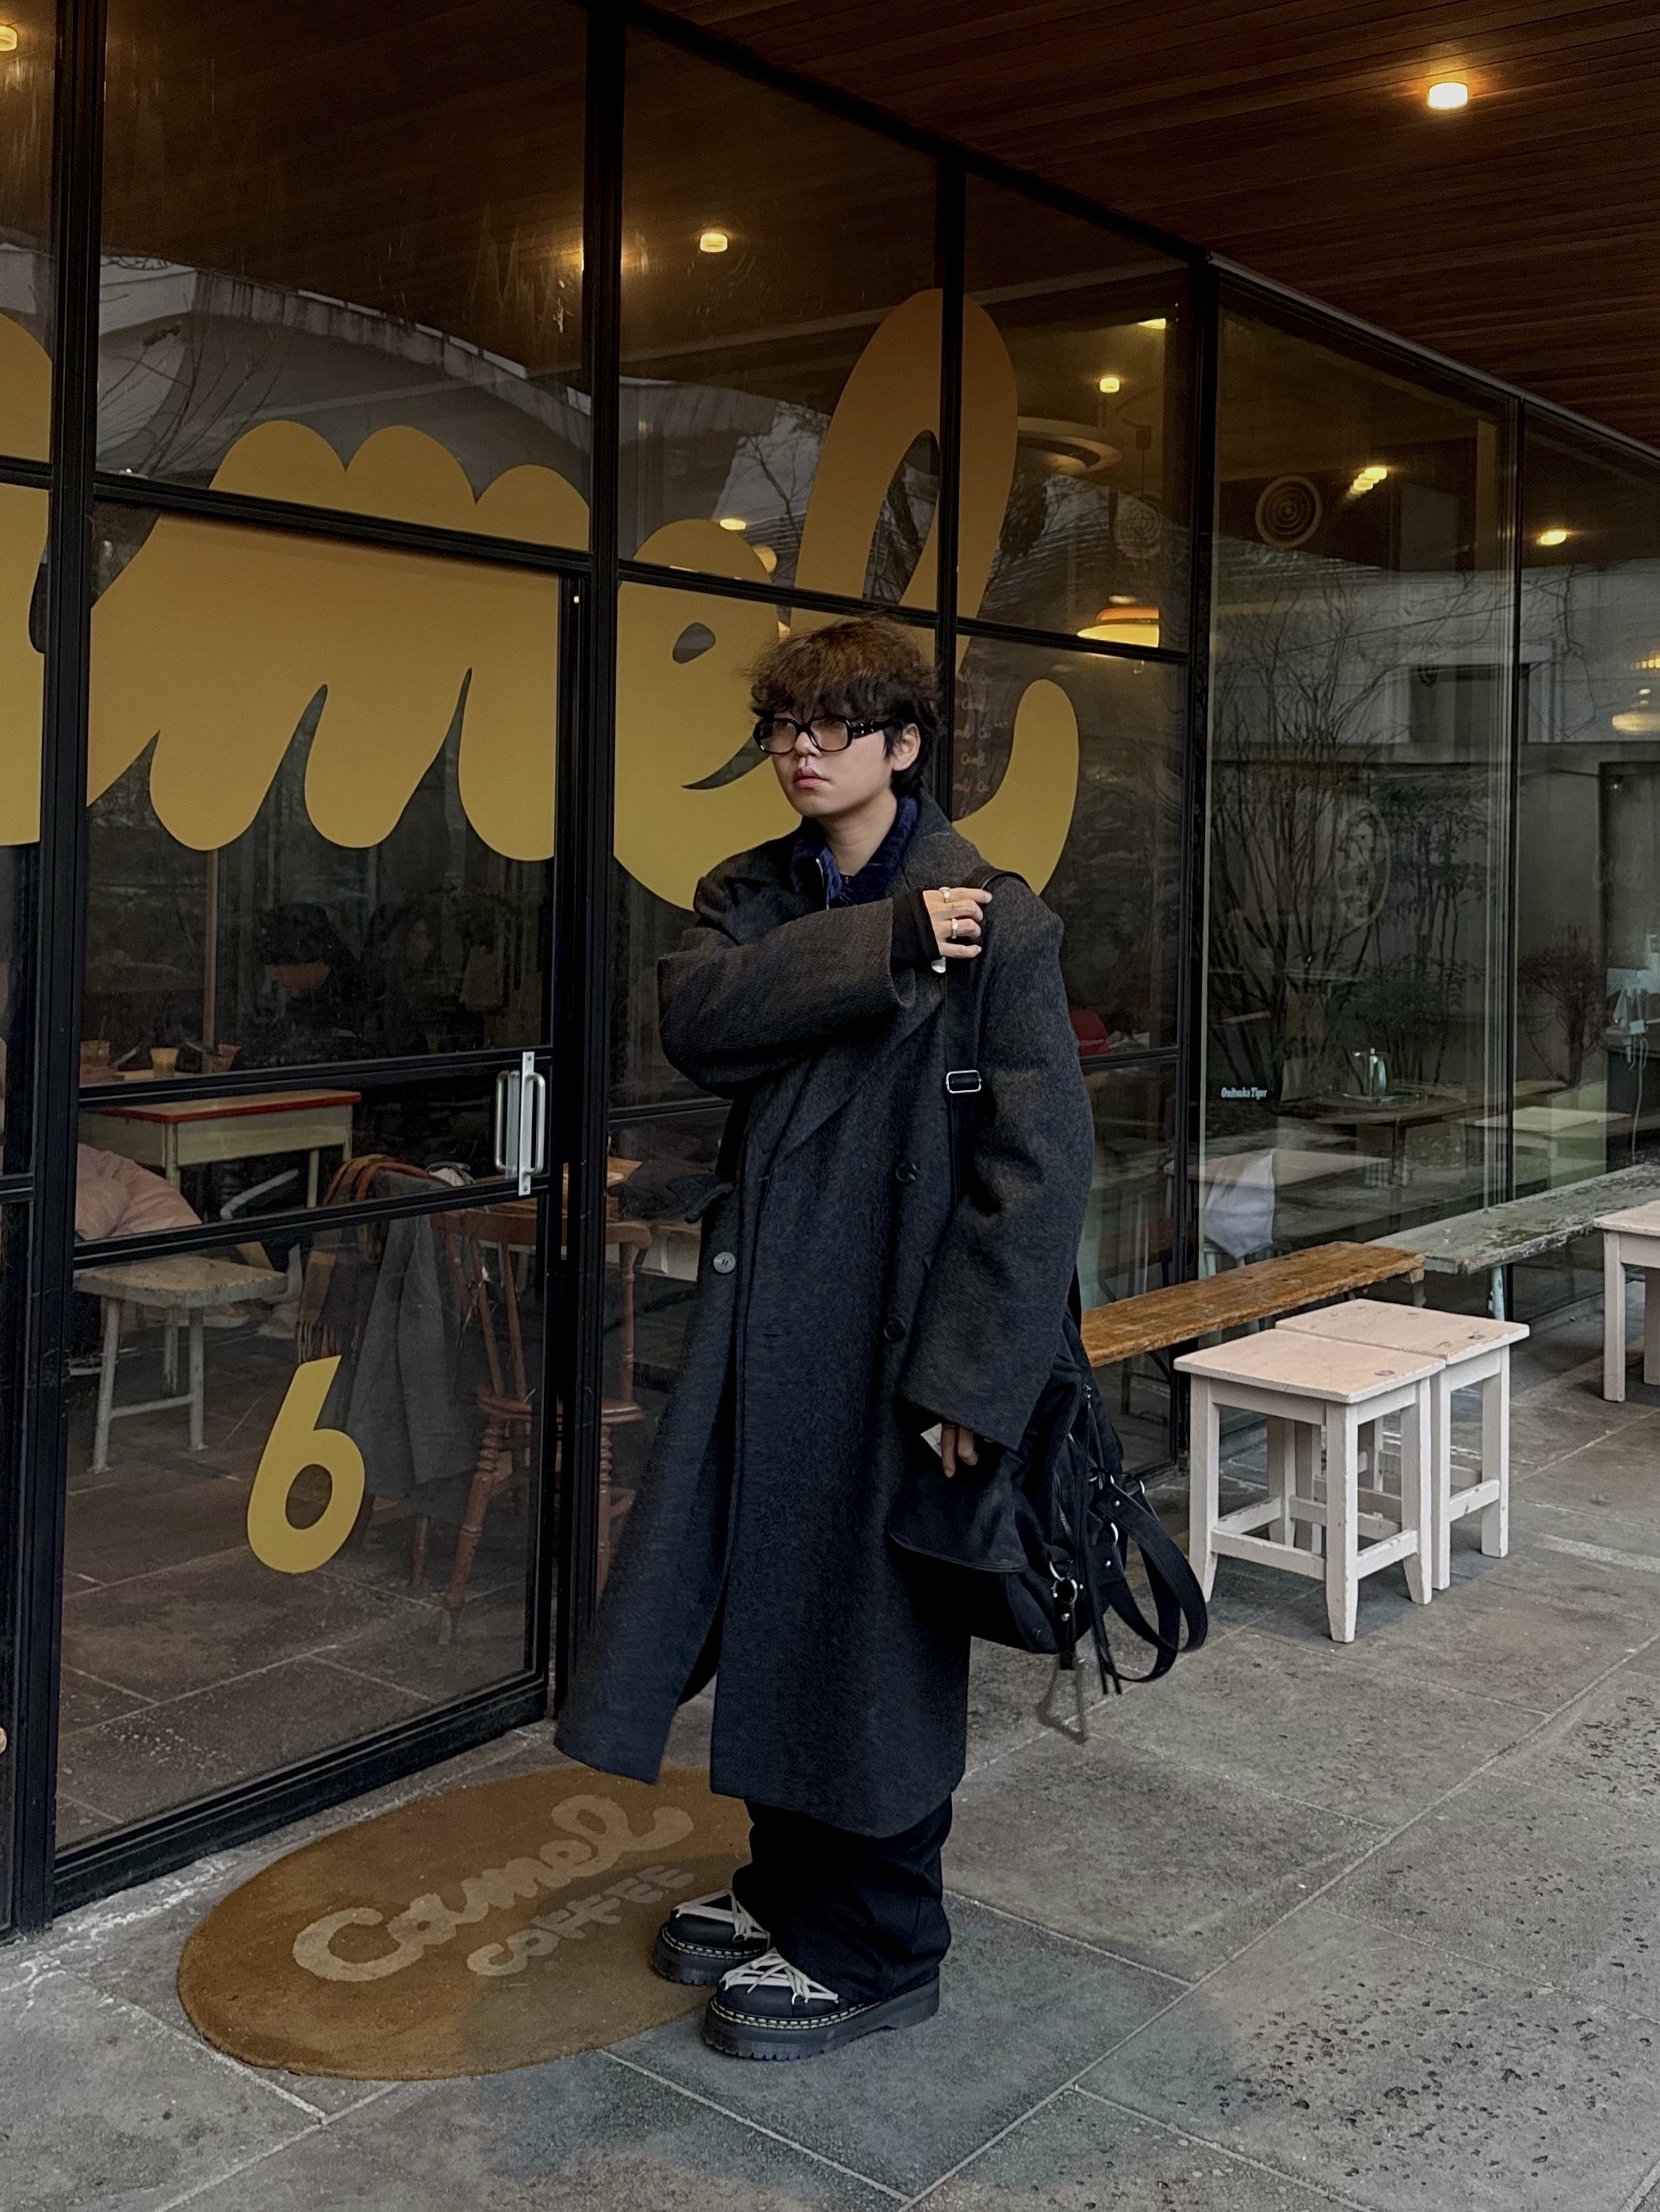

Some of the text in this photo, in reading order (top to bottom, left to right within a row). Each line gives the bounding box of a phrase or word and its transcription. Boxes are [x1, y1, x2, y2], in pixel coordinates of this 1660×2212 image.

[1251, 1087, 1268, 1100] Tiger
[247, 1355, 365, 1574] 6
[293, 1794, 694, 1982] Camel
